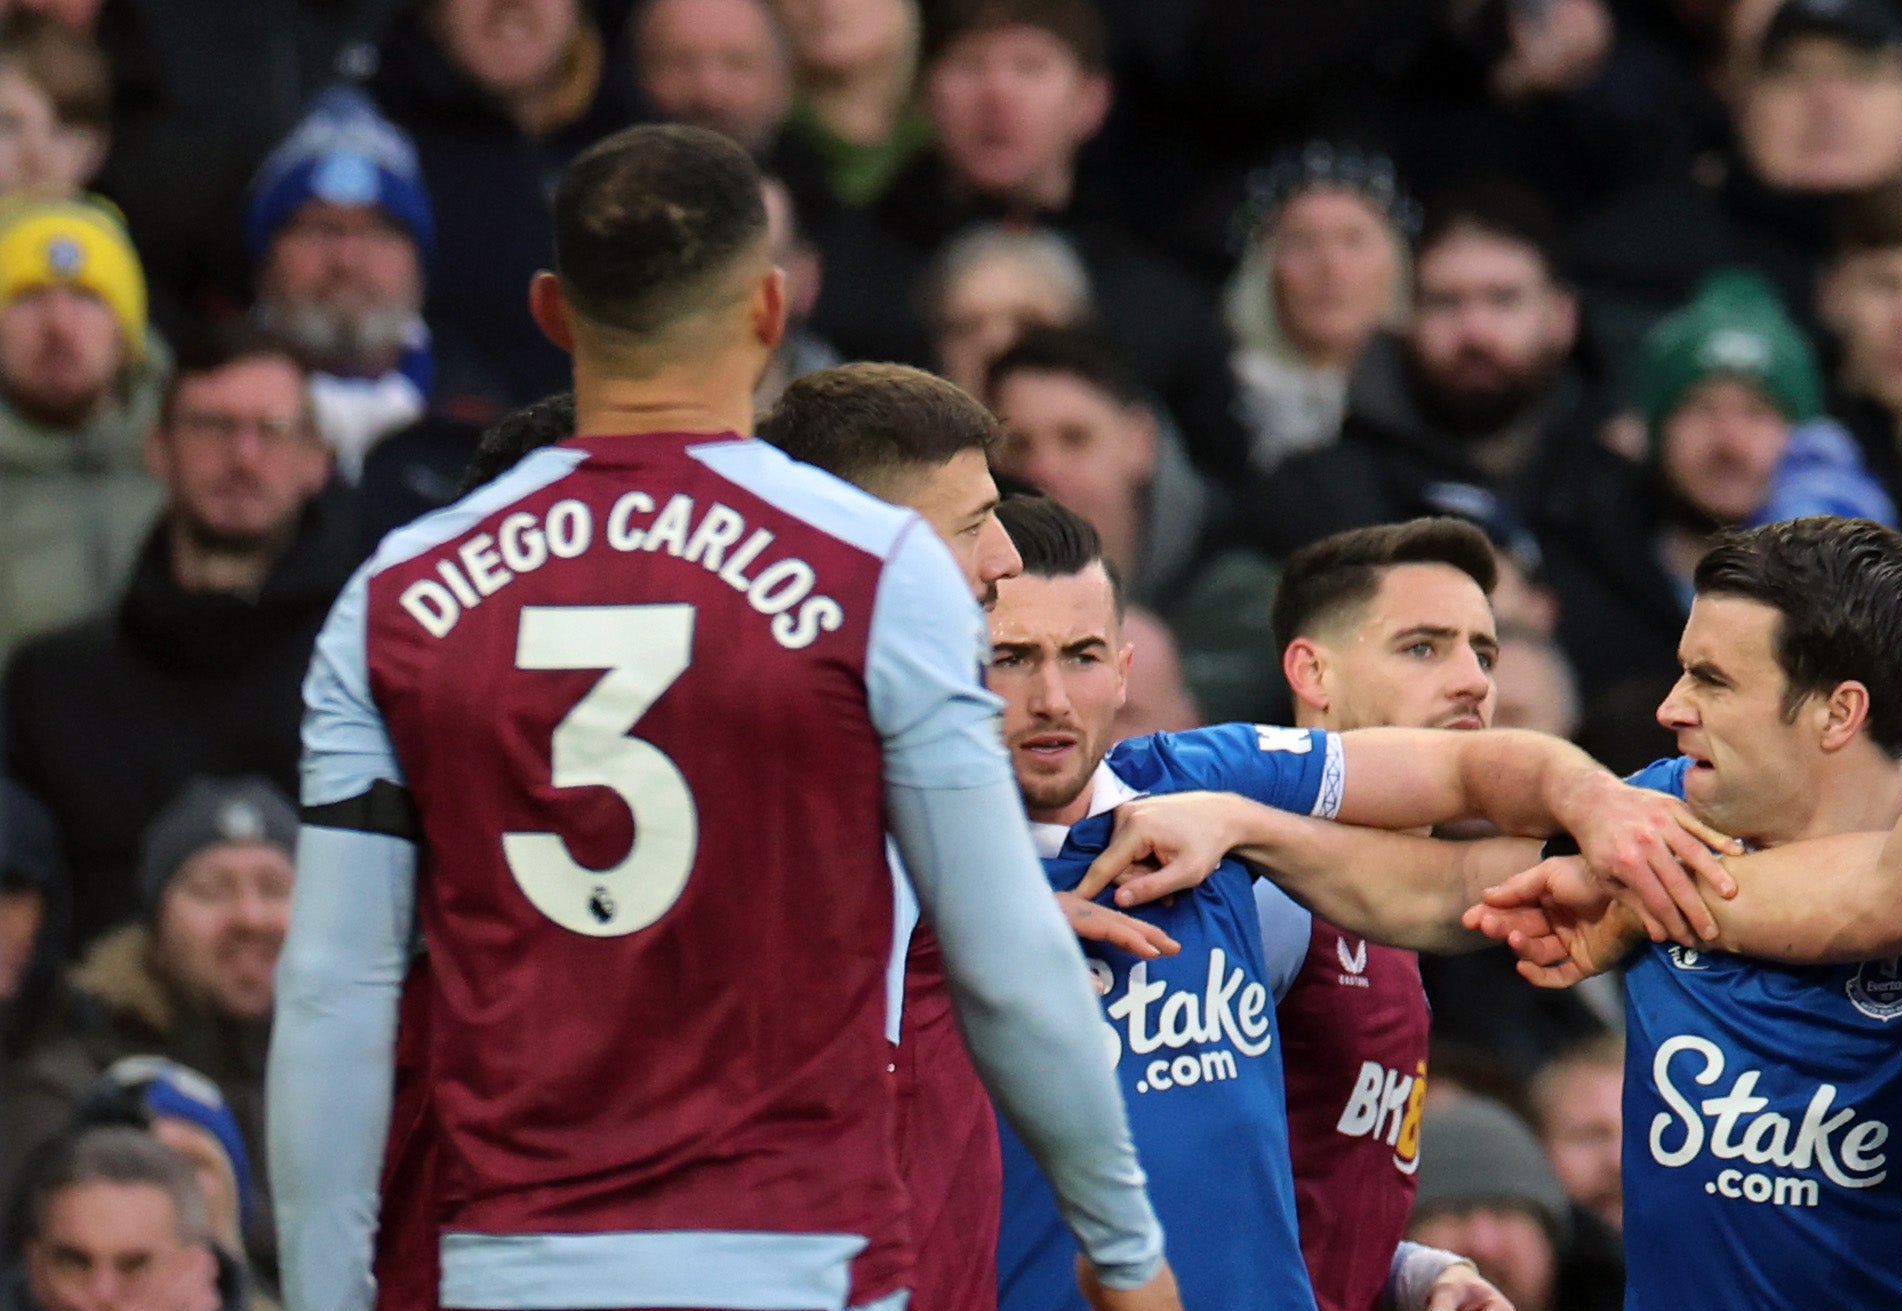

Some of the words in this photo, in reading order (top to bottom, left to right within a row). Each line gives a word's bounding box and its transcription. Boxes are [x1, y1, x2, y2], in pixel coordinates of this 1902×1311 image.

[399, 499, 594, 639] DIEGO
[607, 492, 845, 650] CARLOS
[502, 603, 698, 937] 3
[1136, 1049, 1237, 1093] .com
[1650, 1034, 1889, 1188] Stake
[1704, 1168, 1819, 1206] .com
